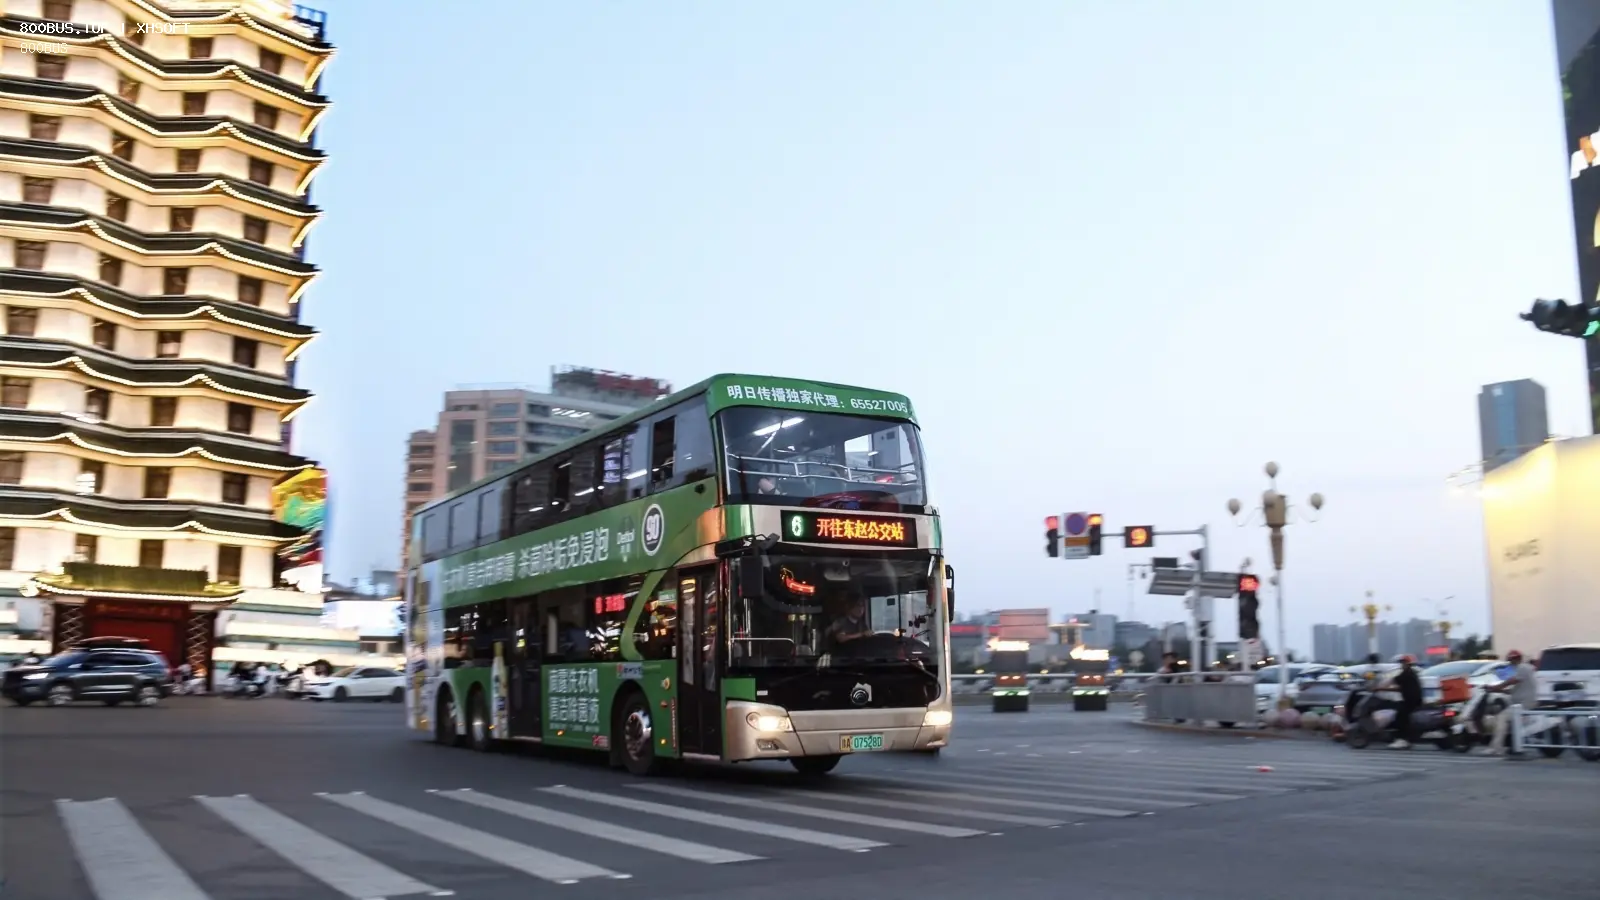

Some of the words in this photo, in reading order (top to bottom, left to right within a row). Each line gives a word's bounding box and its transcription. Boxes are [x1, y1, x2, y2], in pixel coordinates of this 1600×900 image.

[791, 515, 804, 536] 6
[816, 518, 905, 541] 开往东赵公交站
[1130, 527, 1148, 546] 9
